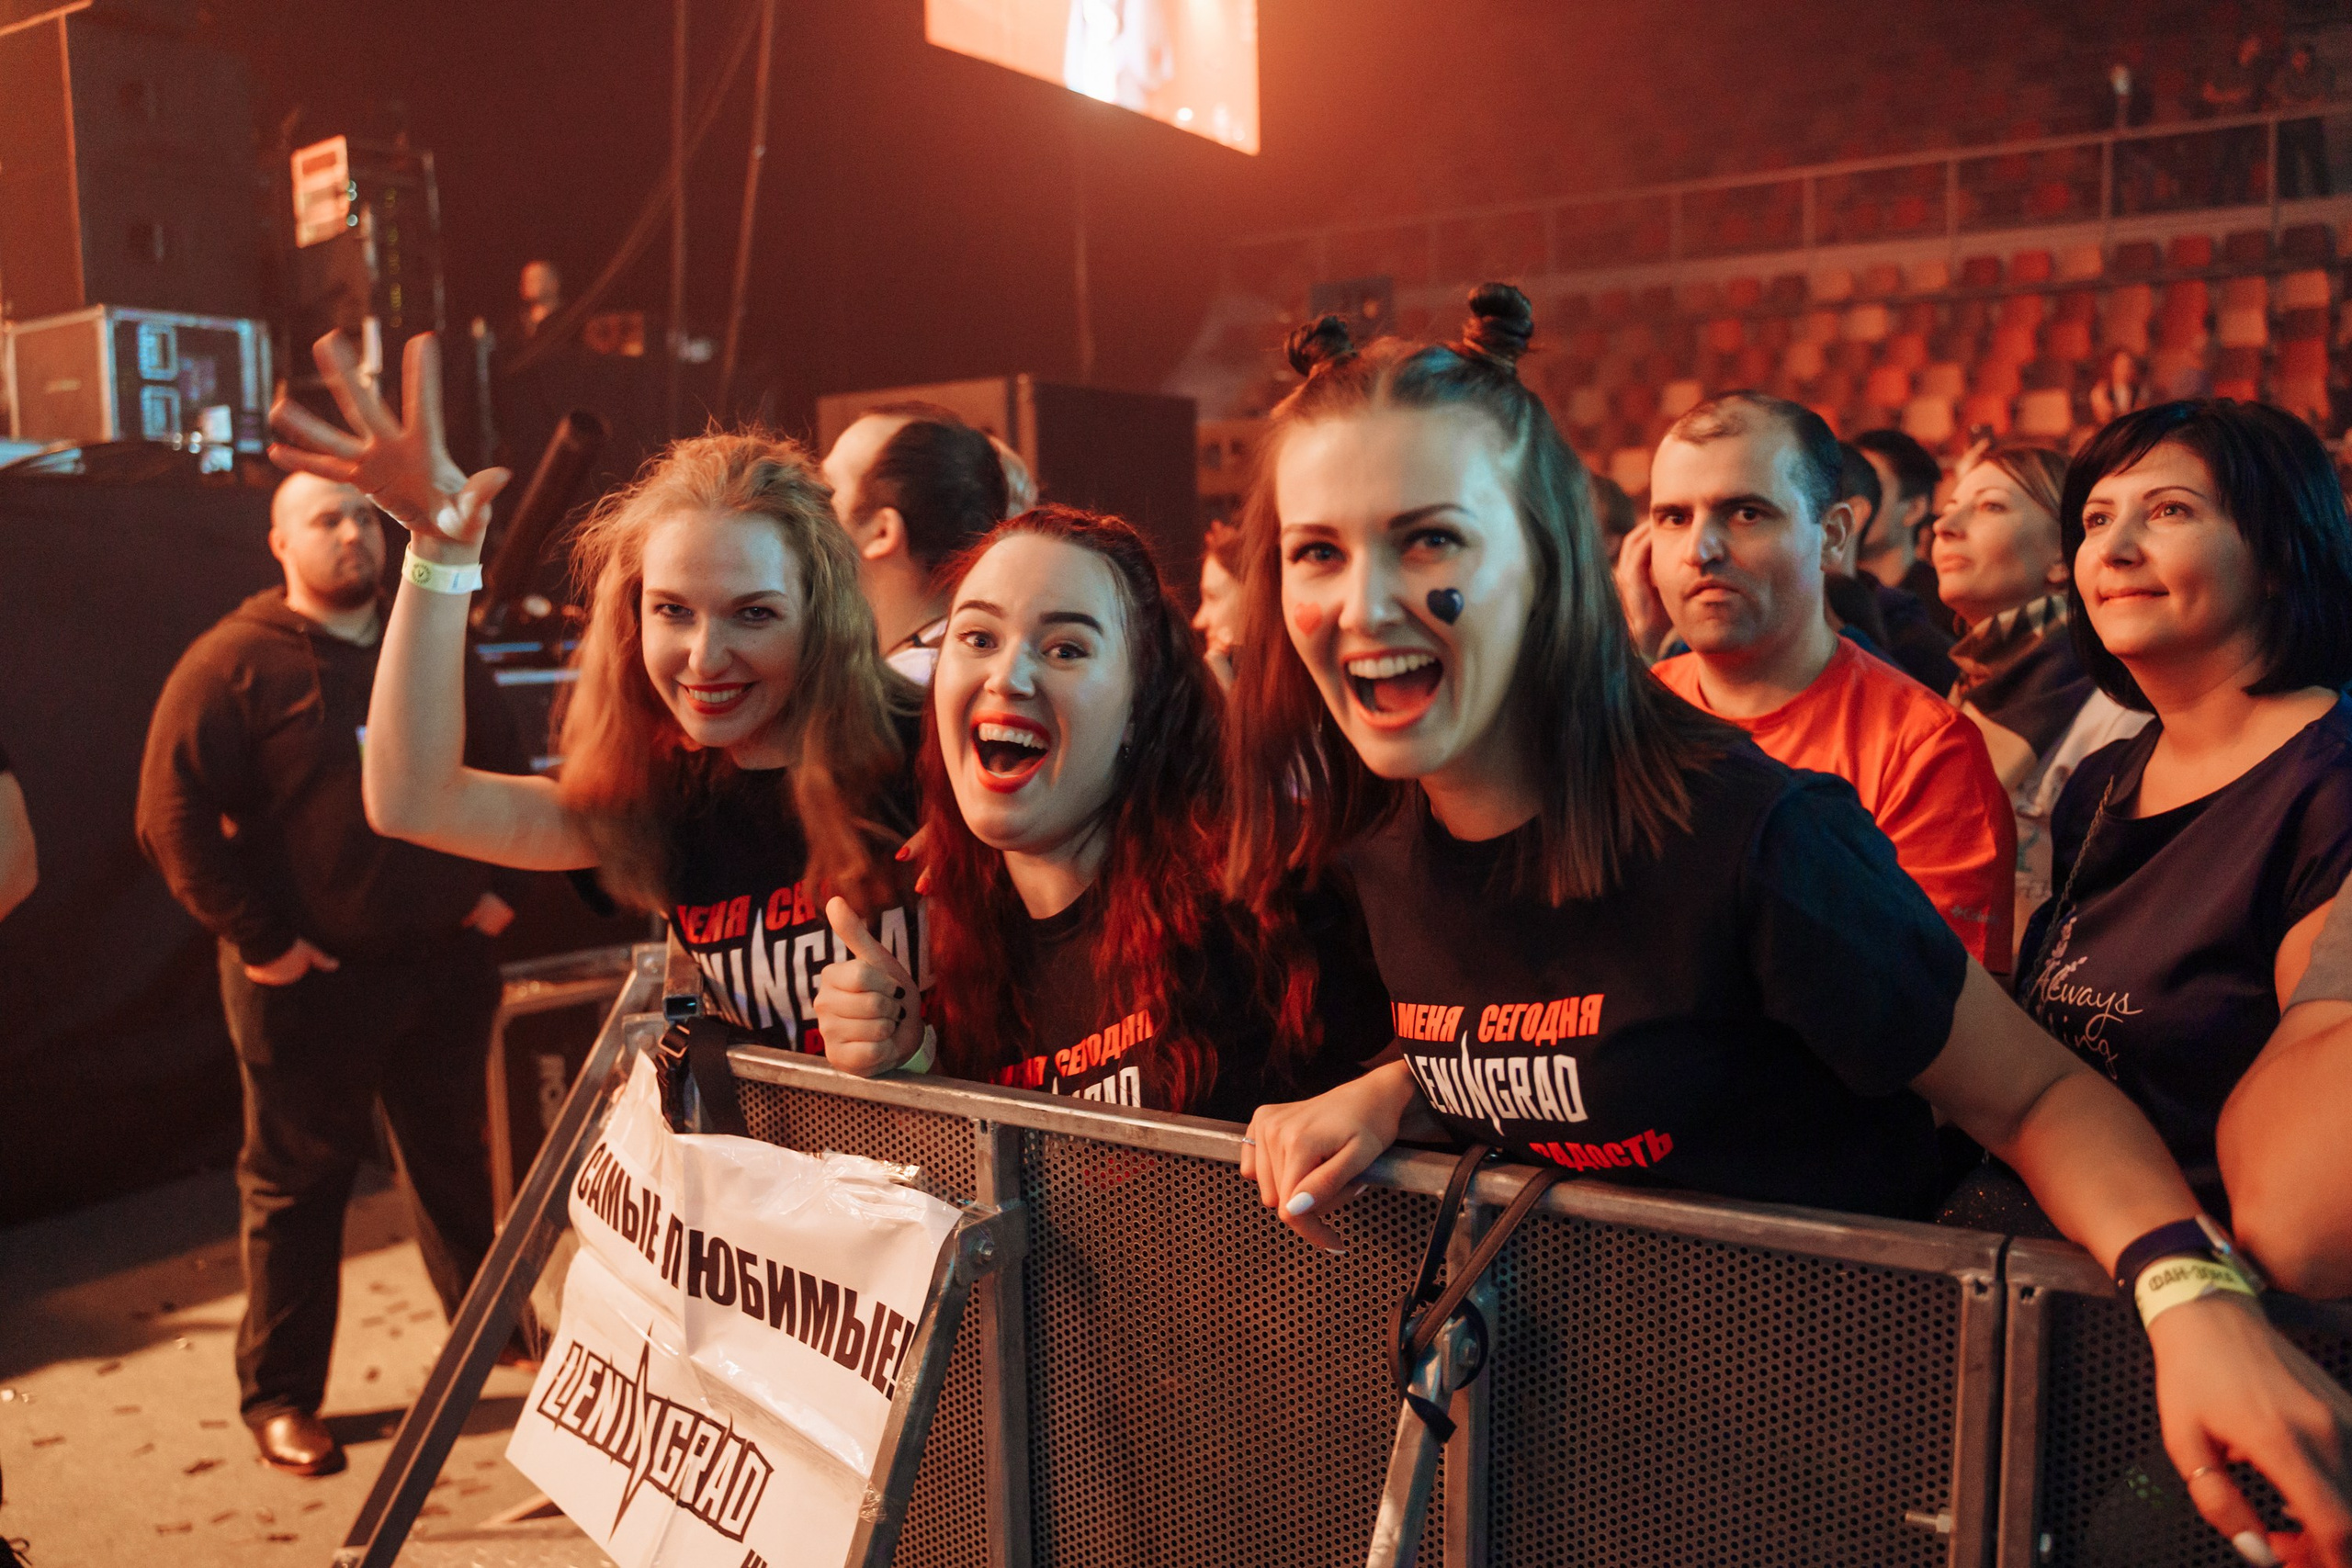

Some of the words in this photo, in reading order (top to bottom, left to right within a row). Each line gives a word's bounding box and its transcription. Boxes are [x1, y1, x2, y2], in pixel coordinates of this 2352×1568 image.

[1055, 1010, 1153, 1077] СЕГОДНЯ
[1398, 1003, 1464, 1042] МЕНЯ
[1477, 994, 1604, 1046] СЕГОДНЯ
[577, 1142, 662, 1264] САМЫЕ
[662, 1213, 915, 1402] ЛЮБИМЫЕ!
[537, 1320, 775, 1543] LENINGRAD
